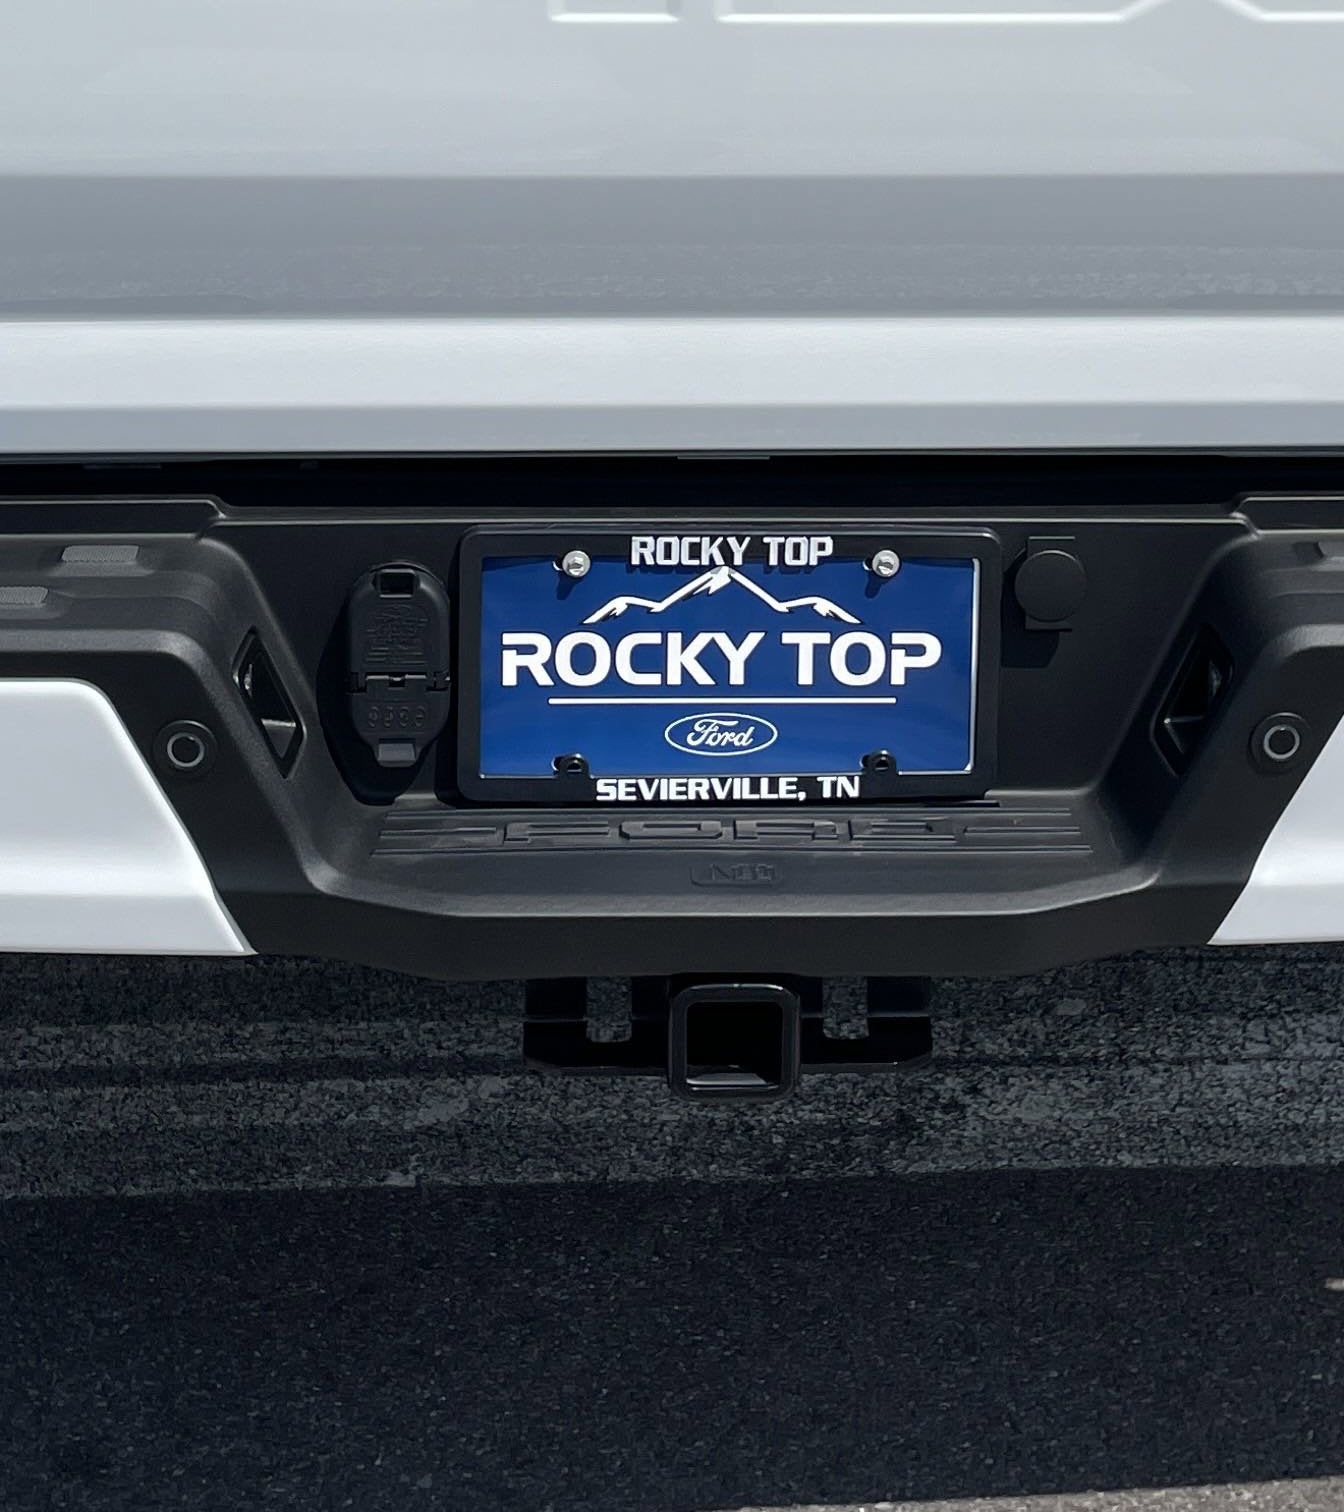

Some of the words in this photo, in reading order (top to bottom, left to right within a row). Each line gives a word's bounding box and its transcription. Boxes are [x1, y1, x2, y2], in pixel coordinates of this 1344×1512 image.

[631, 536, 750, 567] ROCKY
[763, 536, 834, 566] TOP
[502, 631, 766, 687] ROCKY
[781, 631, 943, 686] TOP
[686, 719, 756, 747] Ford
[595, 776, 806, 801] SEVIERVILLE,
[817, 775, 860, 798] TN
